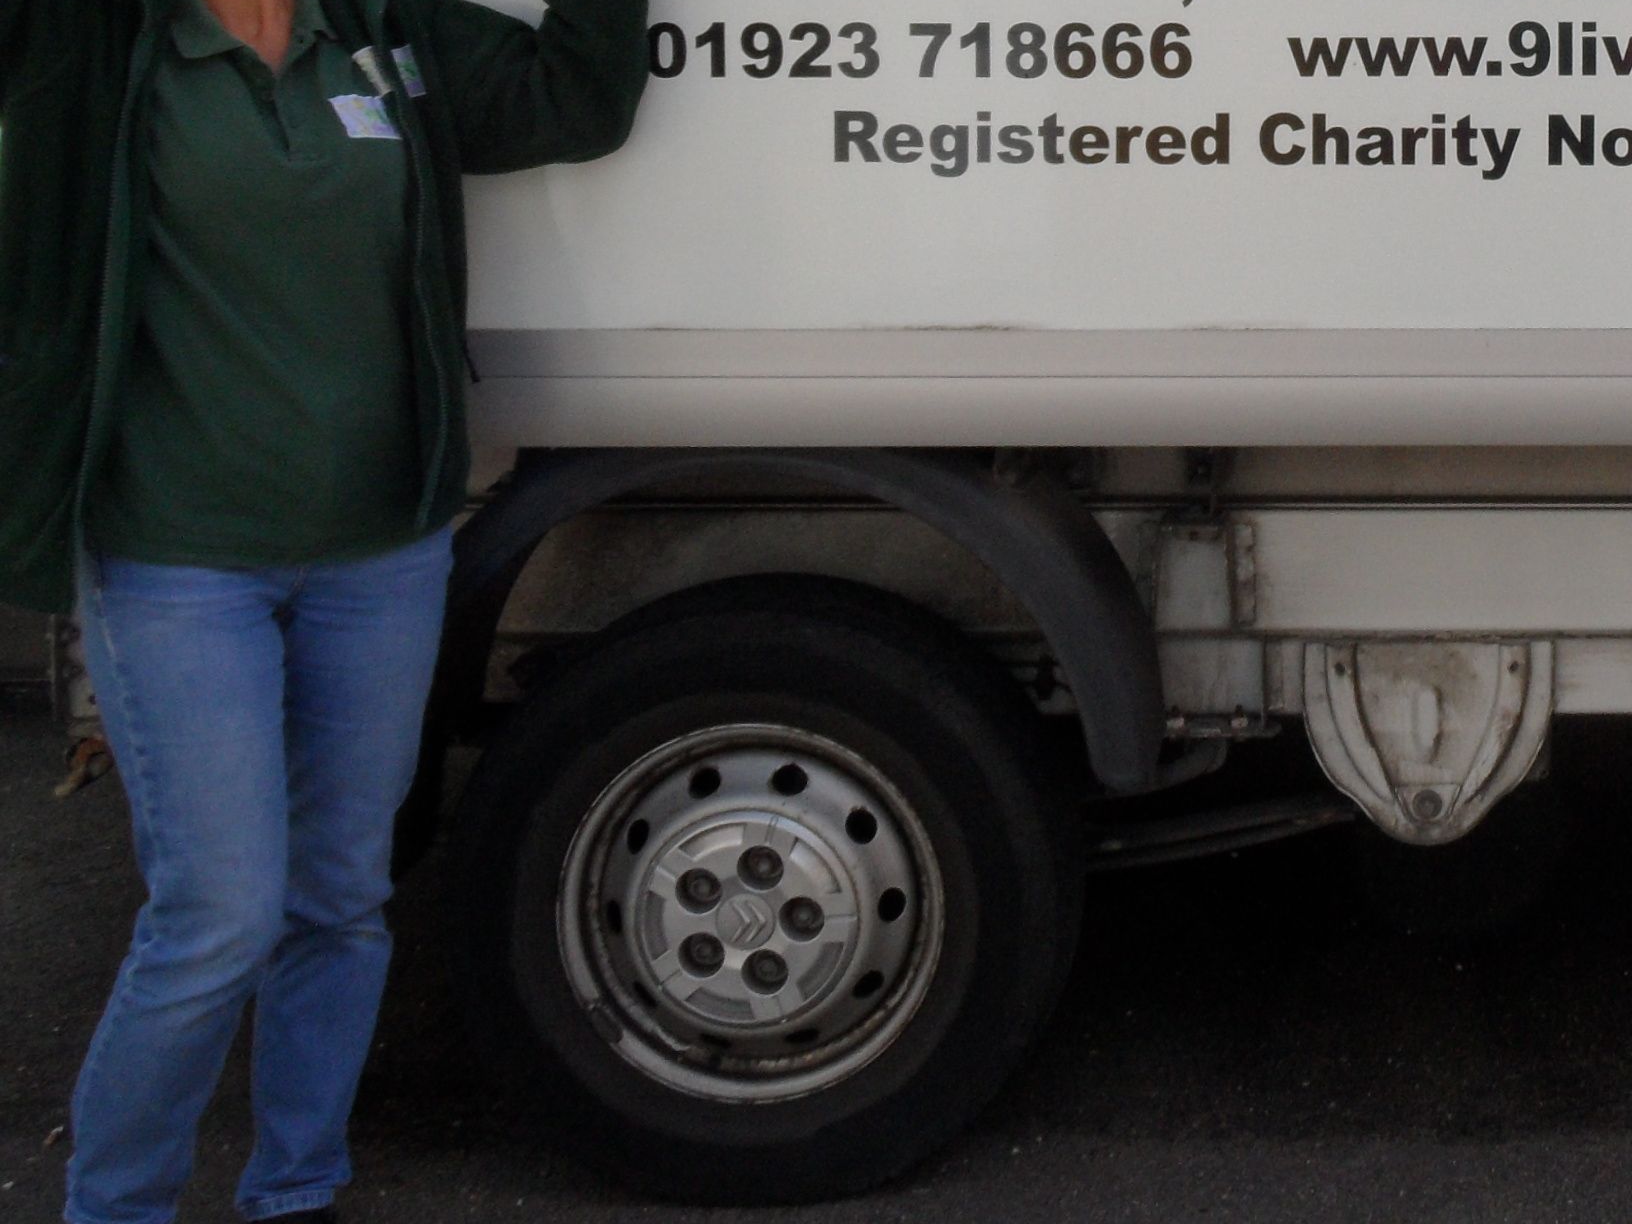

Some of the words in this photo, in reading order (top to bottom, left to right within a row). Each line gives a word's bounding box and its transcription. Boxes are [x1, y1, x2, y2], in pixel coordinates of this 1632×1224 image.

[648, 21, 880, 79] 01923
[909, 22, 1193, 79] 718666
[834, 110, 1230, 178] Registered
[1259, 112, 1521, 181] Charity
